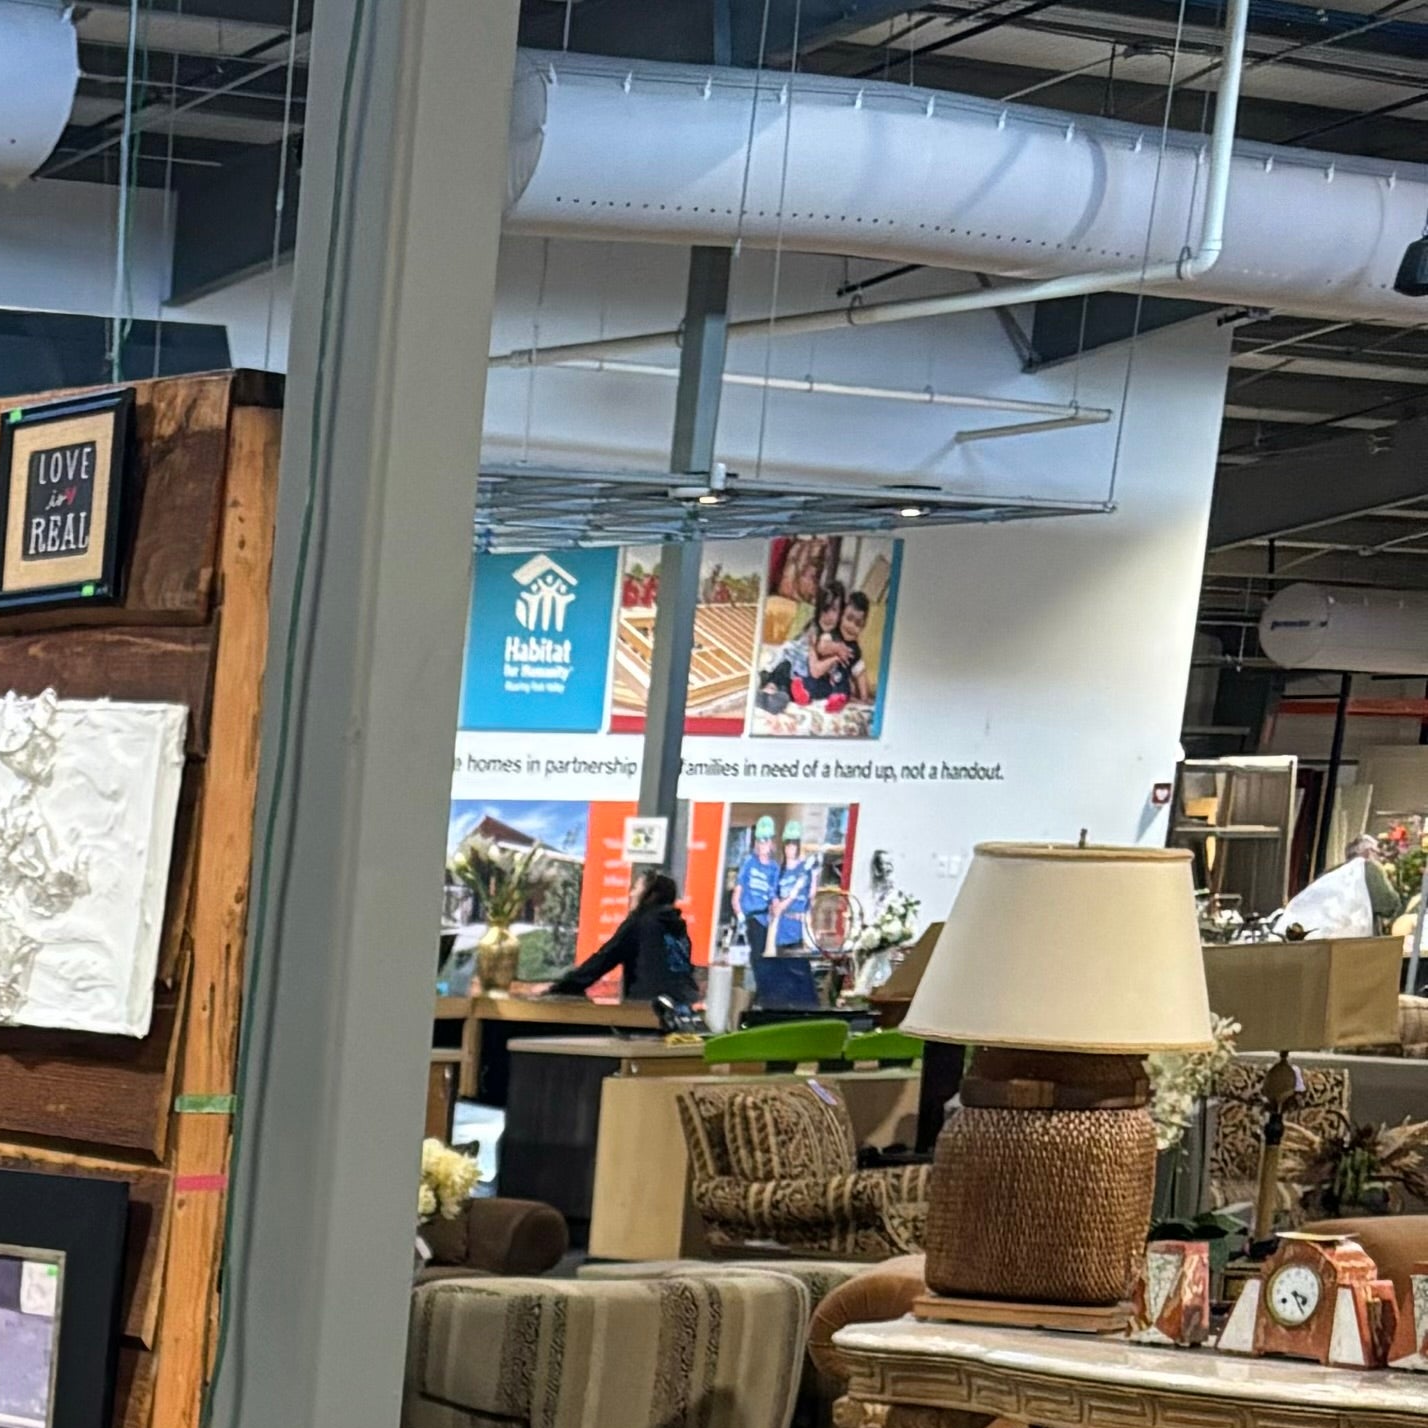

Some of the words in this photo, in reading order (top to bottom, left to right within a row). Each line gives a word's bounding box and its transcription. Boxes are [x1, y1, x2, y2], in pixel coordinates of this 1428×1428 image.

[38, 447, 92, 485] LOVE
[28, 511, 90, 555] REAL
[504, 636, 572, 664] Habitat
[467, 754, 522, 773] homes
[526, 754, 541, 773] in
[544, 756, 638, 778] partnership
[744, 757, 757, 777] in
[760, 760, 800, 778] need
[802, 760, 819, 778] of
[821, 763, 831, 778] a
[834, 760, 873, 779] hand
[875, 764, 898, 782] up,
[900, 761, 926, 780] not
[928, 765, 939, 780] a
[940, 761, 1005, 781] handout.
